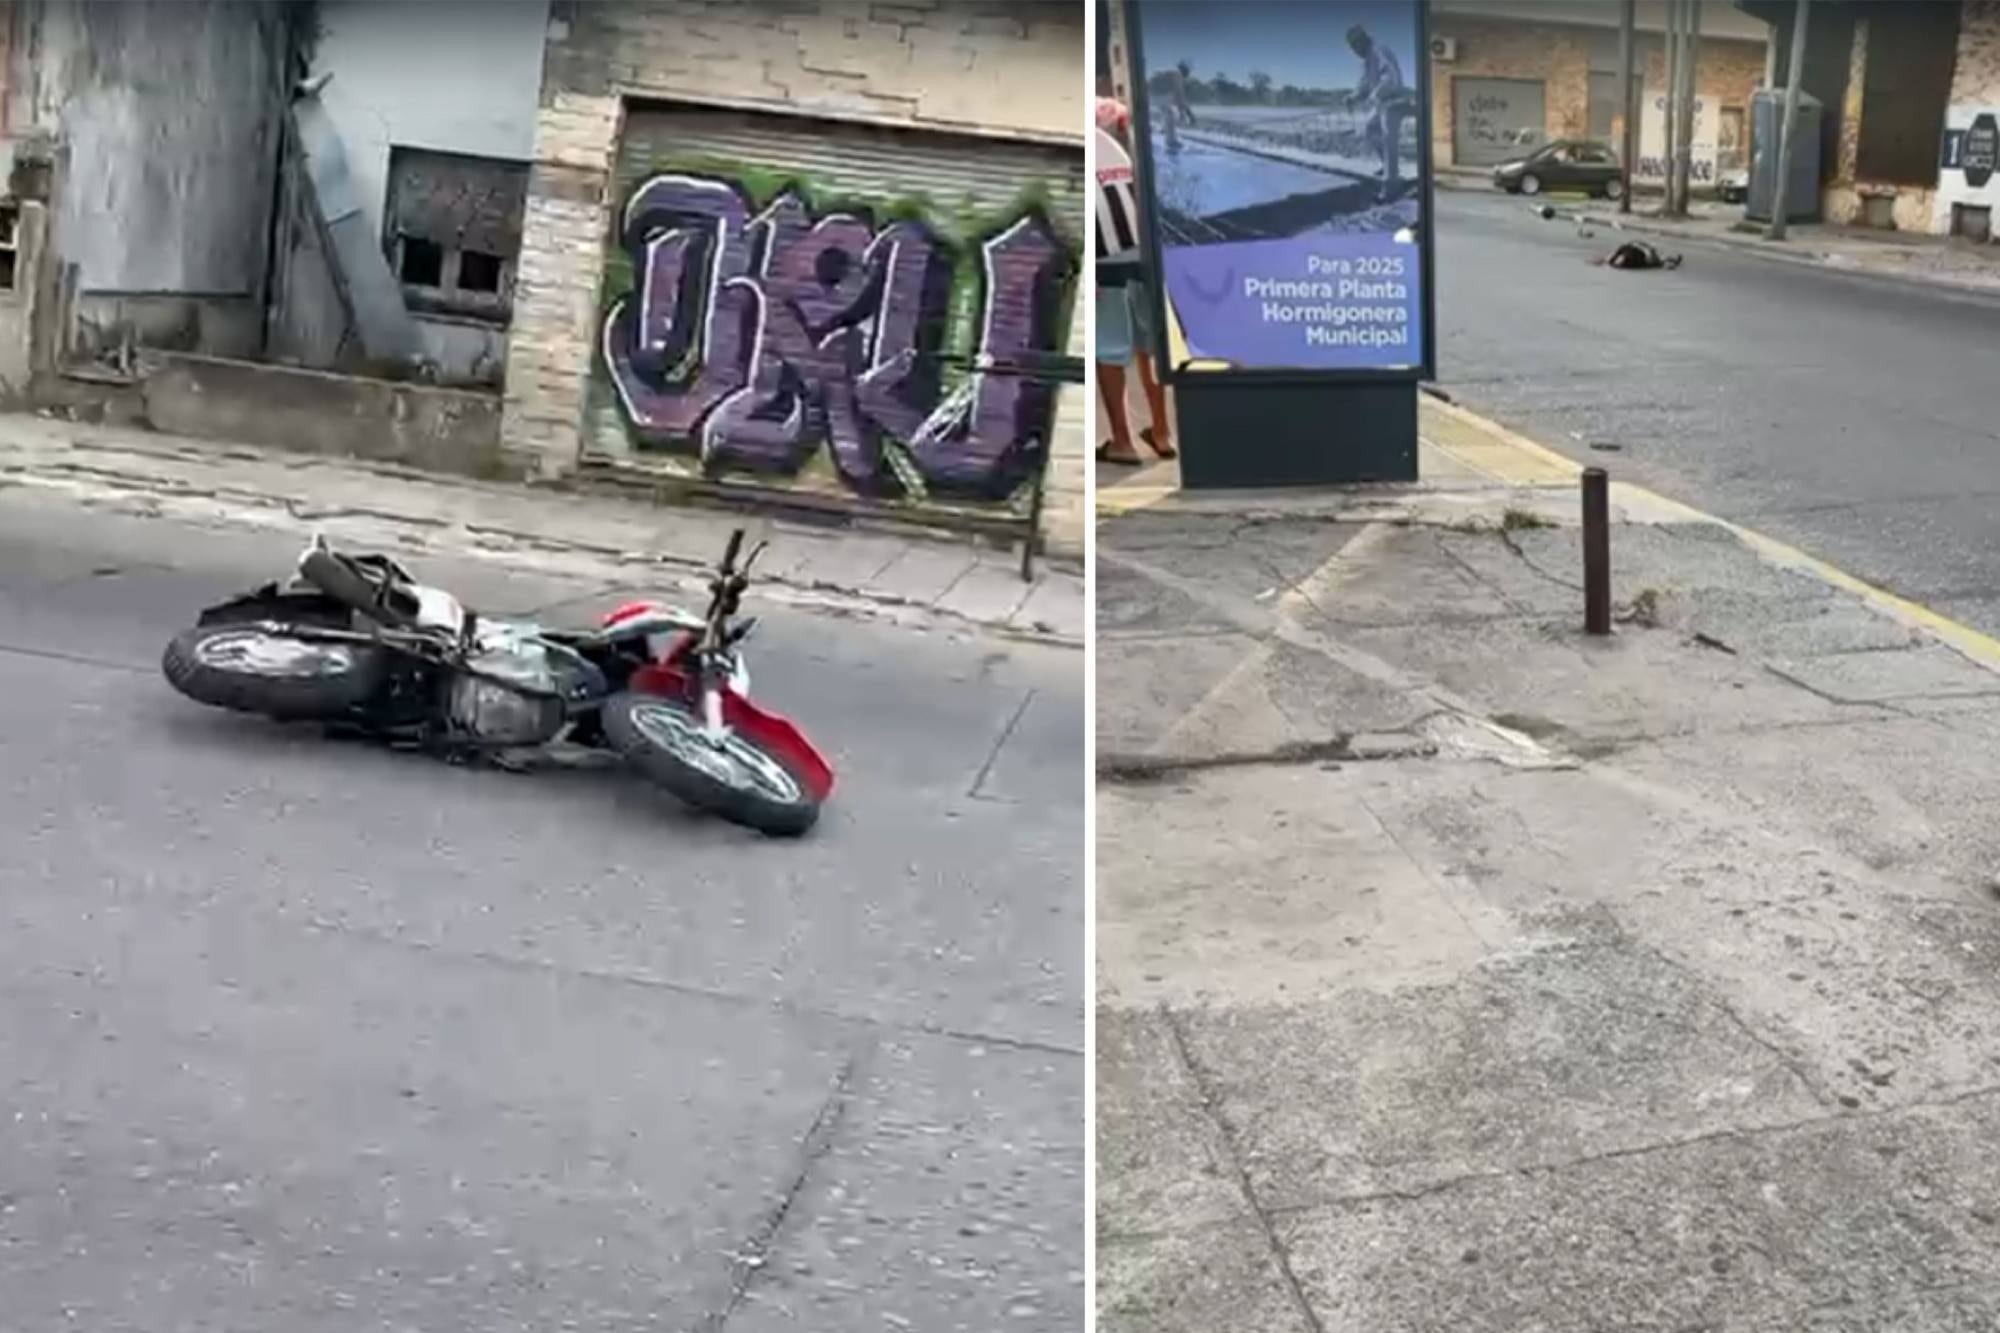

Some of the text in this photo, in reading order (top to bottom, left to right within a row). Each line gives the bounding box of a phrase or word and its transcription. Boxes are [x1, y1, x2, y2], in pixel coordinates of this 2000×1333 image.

[1308, 255, 1405, 275] Para 2025
[1245, 277, 1407, 299] Primera Planta
[1262, 303, 1408, 325] Hormigonera
[1306, 326, 1408, 348] Municipal
